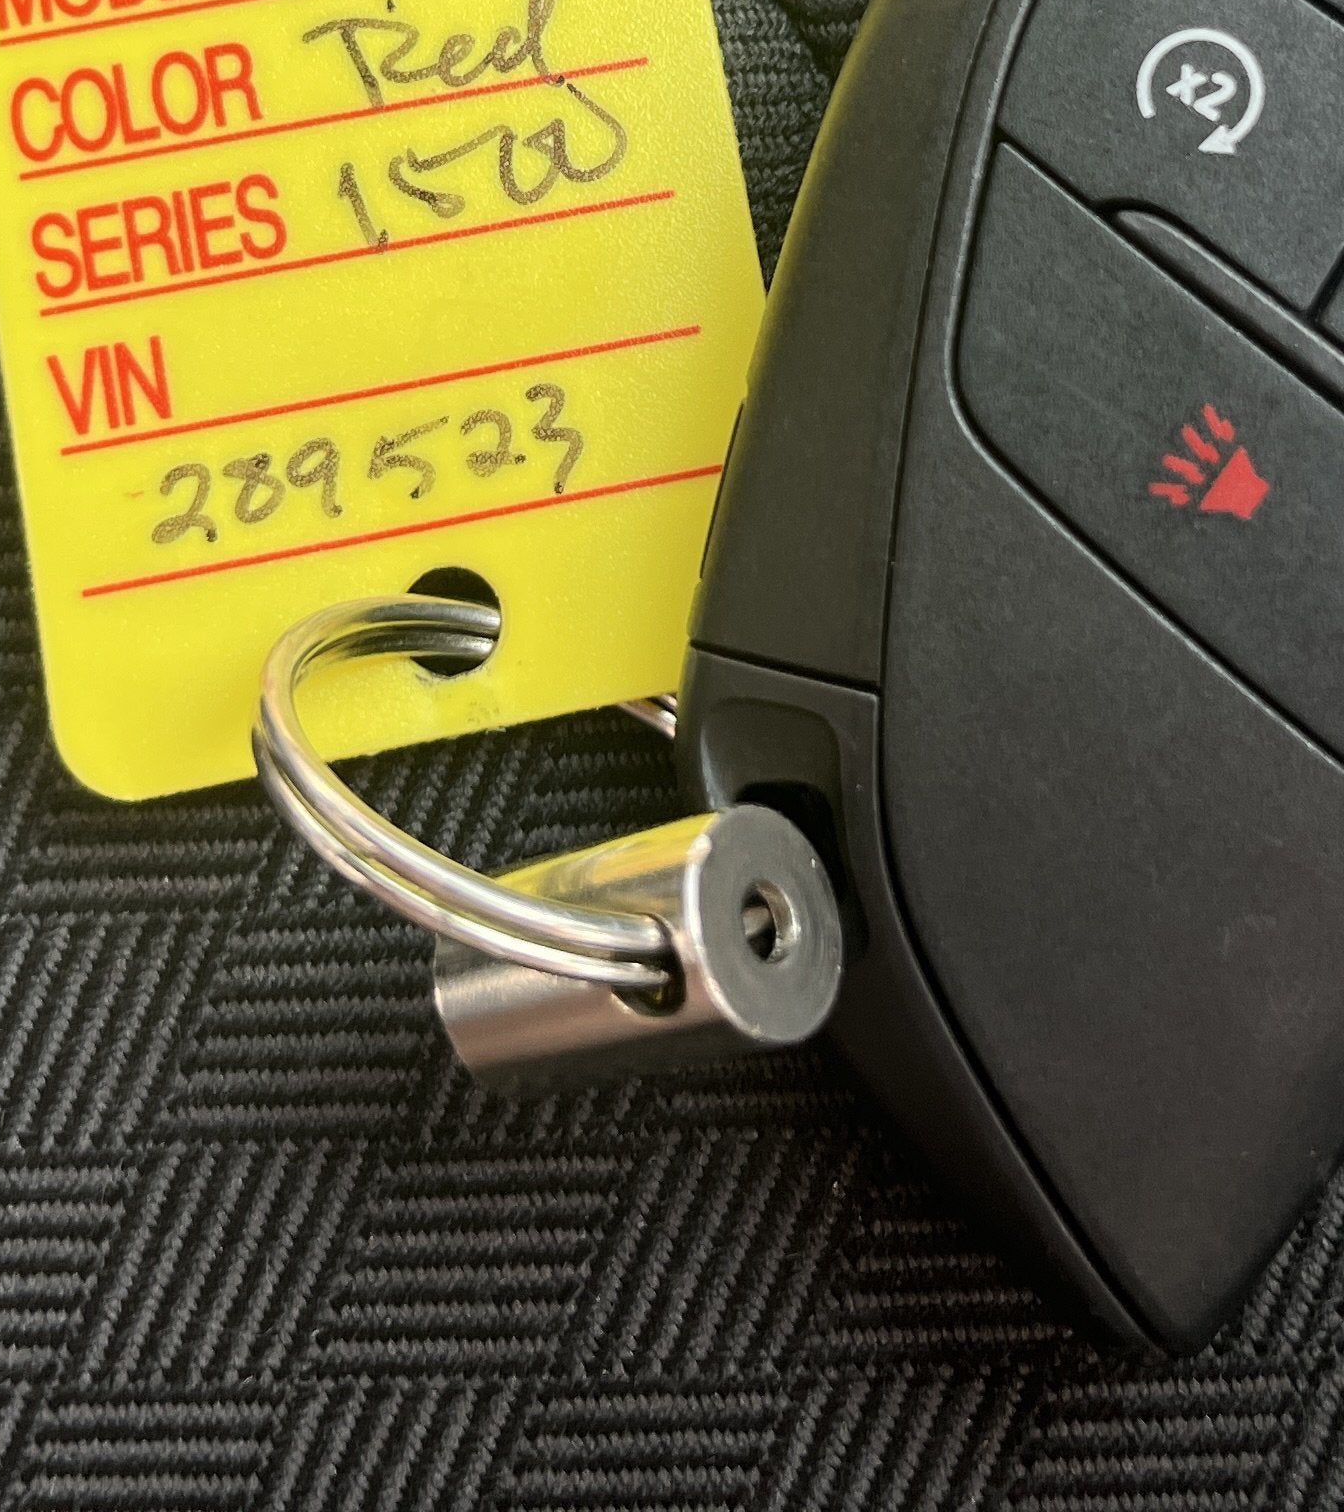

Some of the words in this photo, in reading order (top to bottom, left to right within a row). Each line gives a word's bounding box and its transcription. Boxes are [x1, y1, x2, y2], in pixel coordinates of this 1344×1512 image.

[9, 41, 263, 164] COLOR
[336, 82, 629, 253] 1500
[30, 174, 287, 299] SERIES
[46, 334, 173, 437] VIN
[151, 383, 584, 544] 289523
